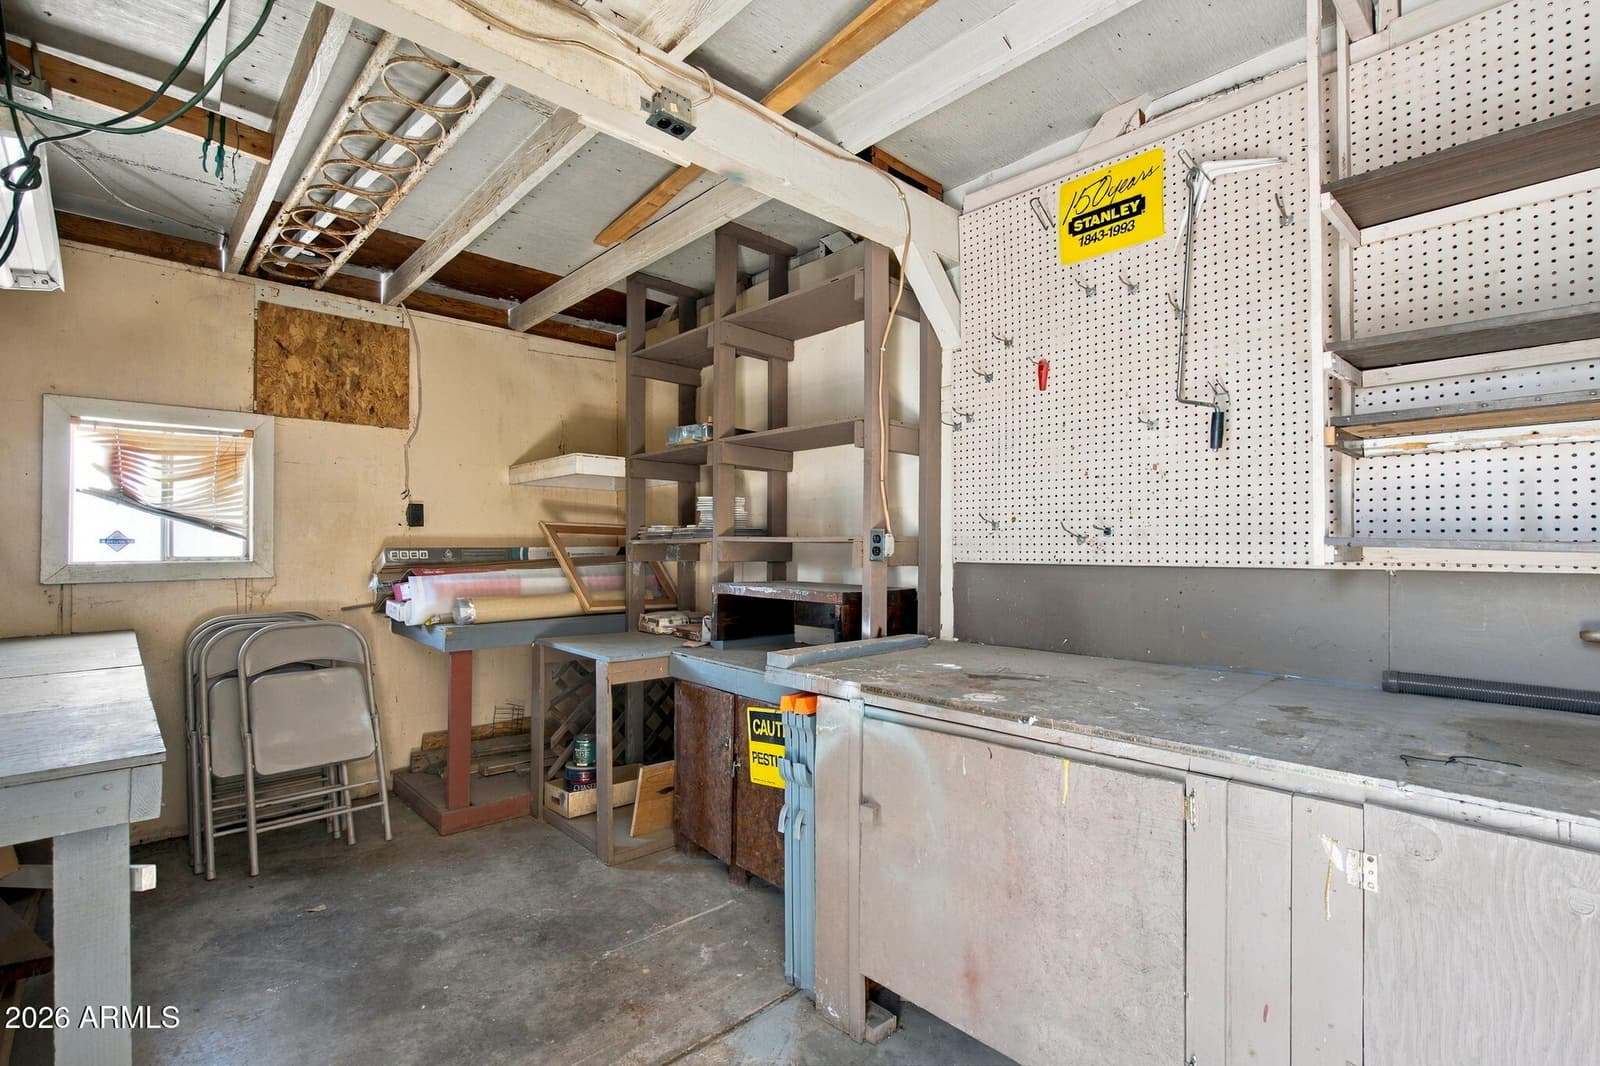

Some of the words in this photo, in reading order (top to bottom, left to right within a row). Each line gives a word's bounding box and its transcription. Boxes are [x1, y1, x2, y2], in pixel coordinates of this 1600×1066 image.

[1062, 174, 1113, 226] 150
[1107, 165, 1160, 205] years
[1073, 199, 1140, 232] STANLEY
[1079, 219, 1135, 247] 1843-1993
[752, 750, 784, 767] PESTI
